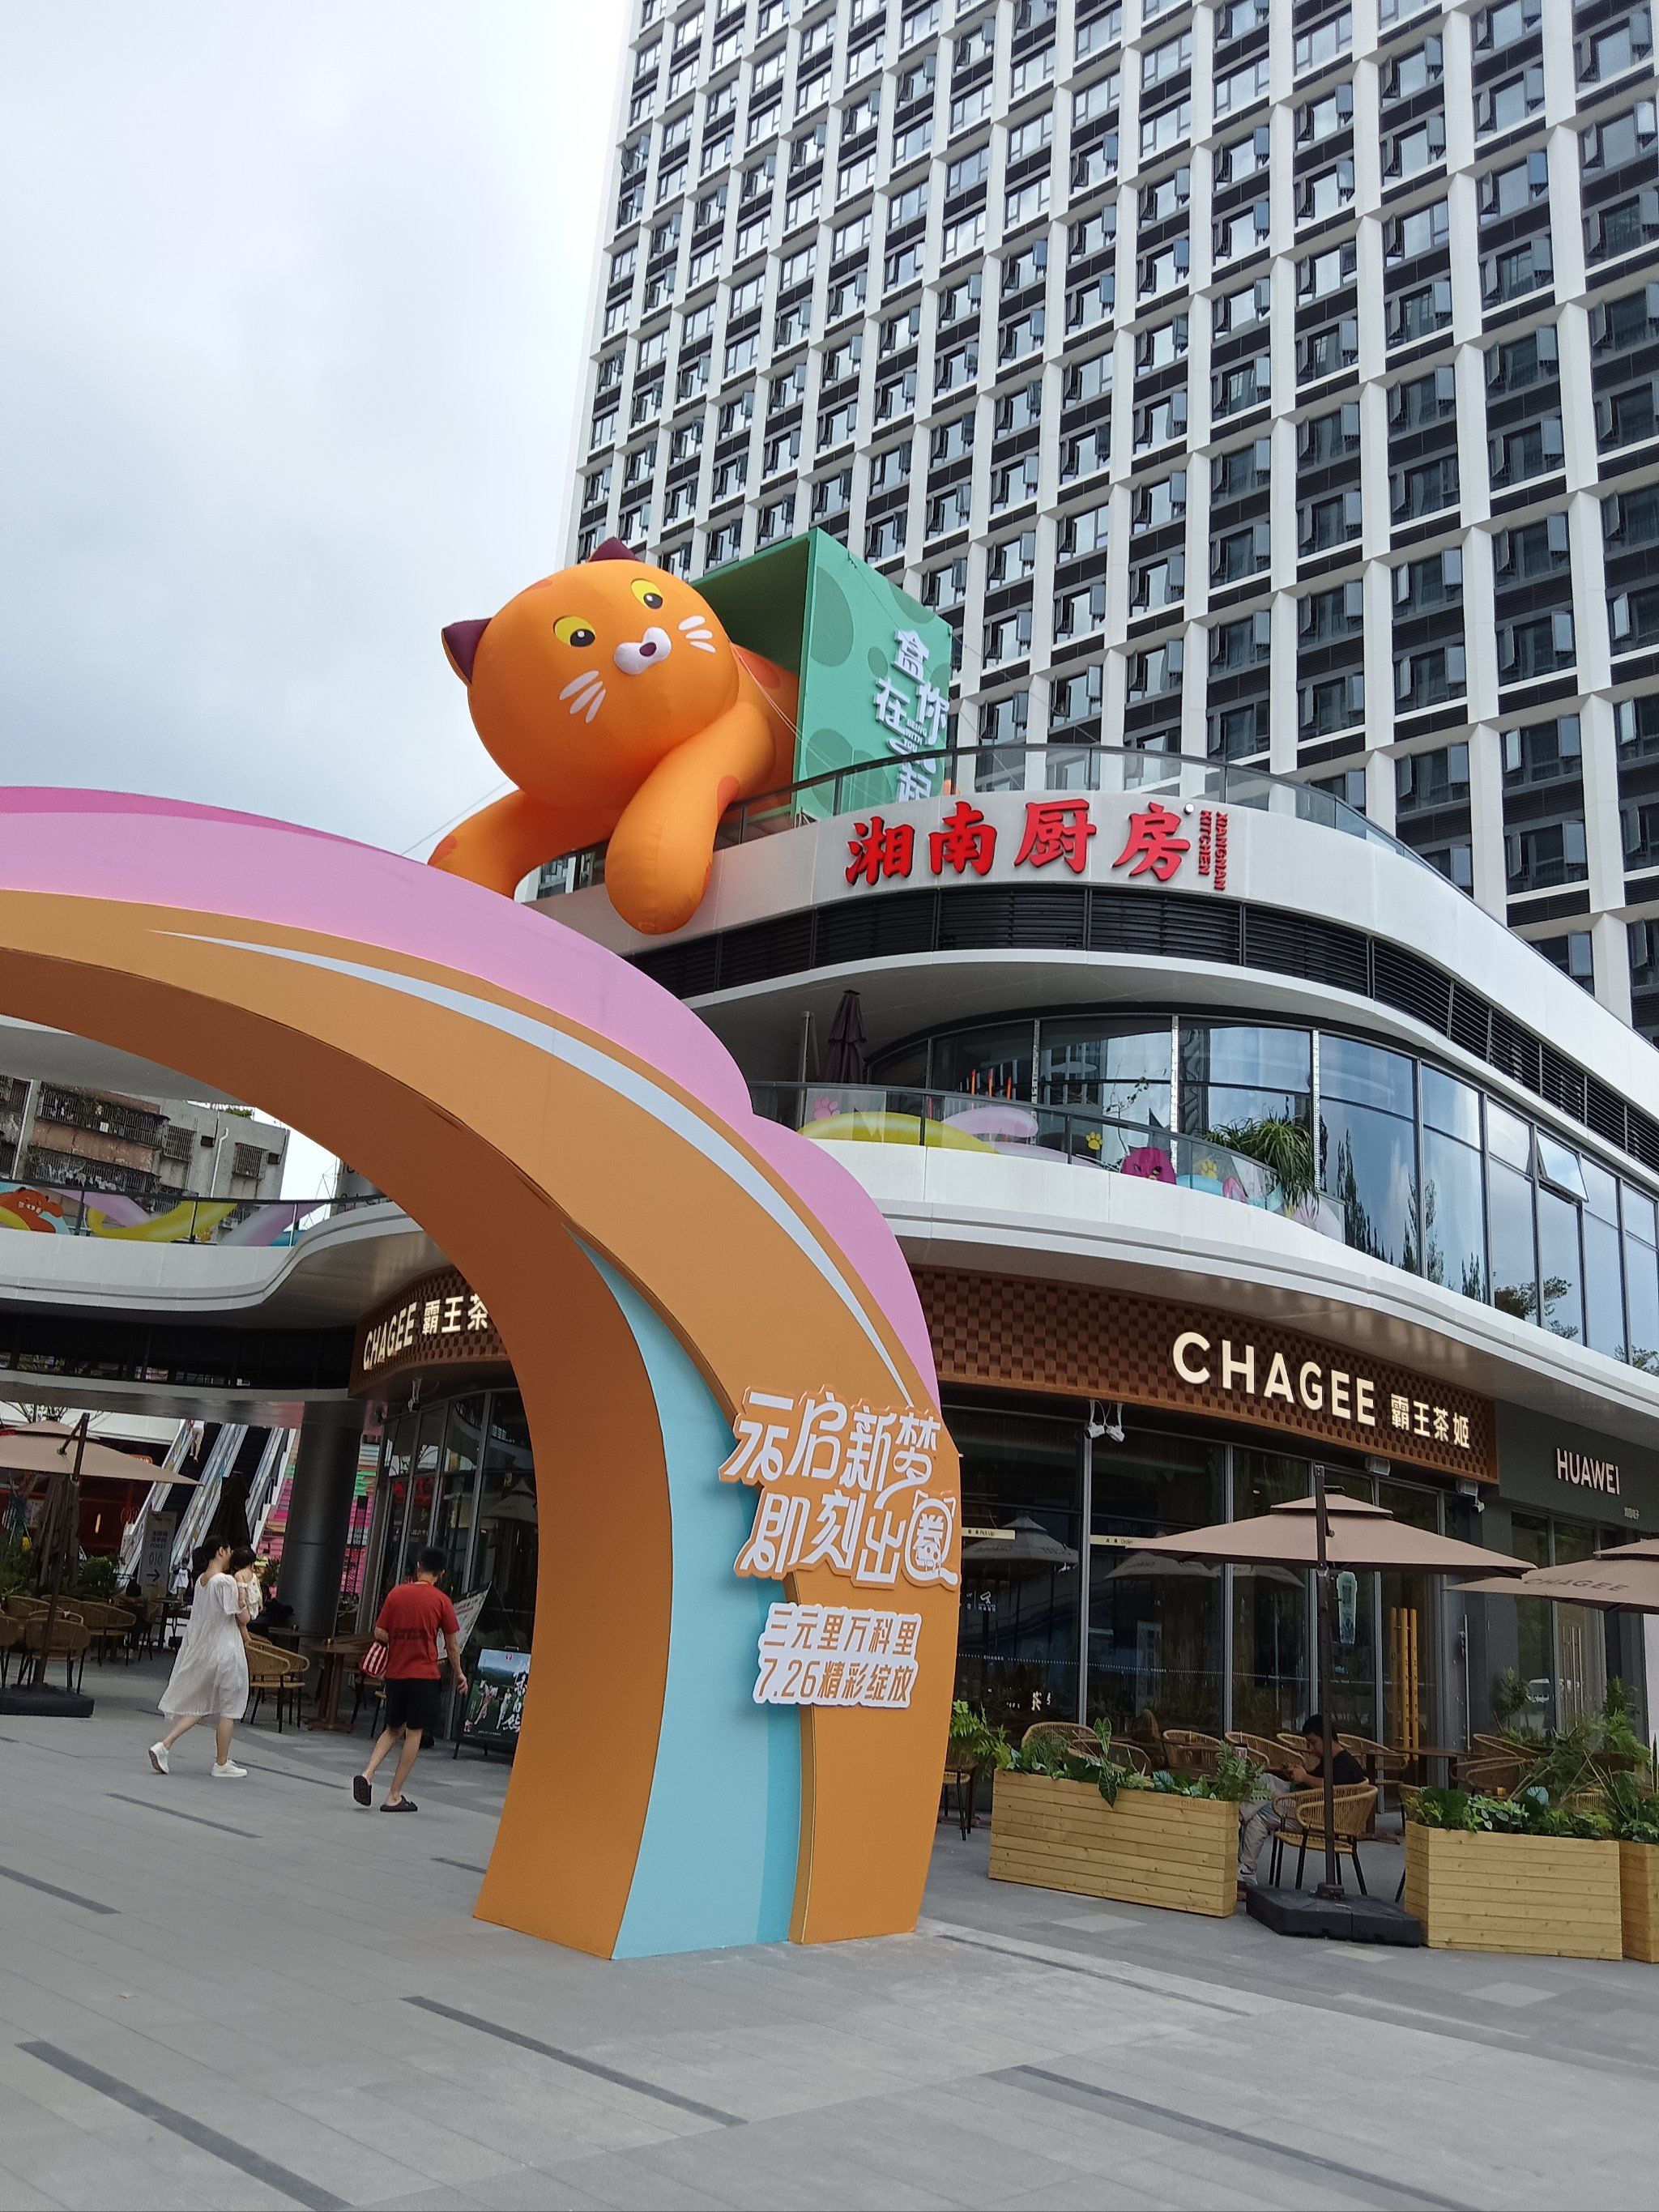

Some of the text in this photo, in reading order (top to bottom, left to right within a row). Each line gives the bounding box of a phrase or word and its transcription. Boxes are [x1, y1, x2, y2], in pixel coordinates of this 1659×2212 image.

[903, 738, 918, 752] YOU
[904, 727, 923, 746] WITH
[906, 718, 928, 737] BEING
[845, 799, 1191, 886] 湘南厨房
[1198, 810, 1212, 876] KITCHEN
[1213, 811, 1228, 891] XIANGNAN
[363, 1302, 417, 1370] CHAGEE
[422, 1294, 488, 1336] 霸王茶
[1172, 1332, 1375, 1427] CHAGEE
[1390, 1393, 1470, 1449] 霸王茶姬
[1556, 1447, 1620, 1496] HUAWEI
[740, 1489, 959, 1586] 即刻出圈
[1524, 1578, 1629, 1592] CHAGEE
[764, 1609, 921, 1656] 三元里万科里
